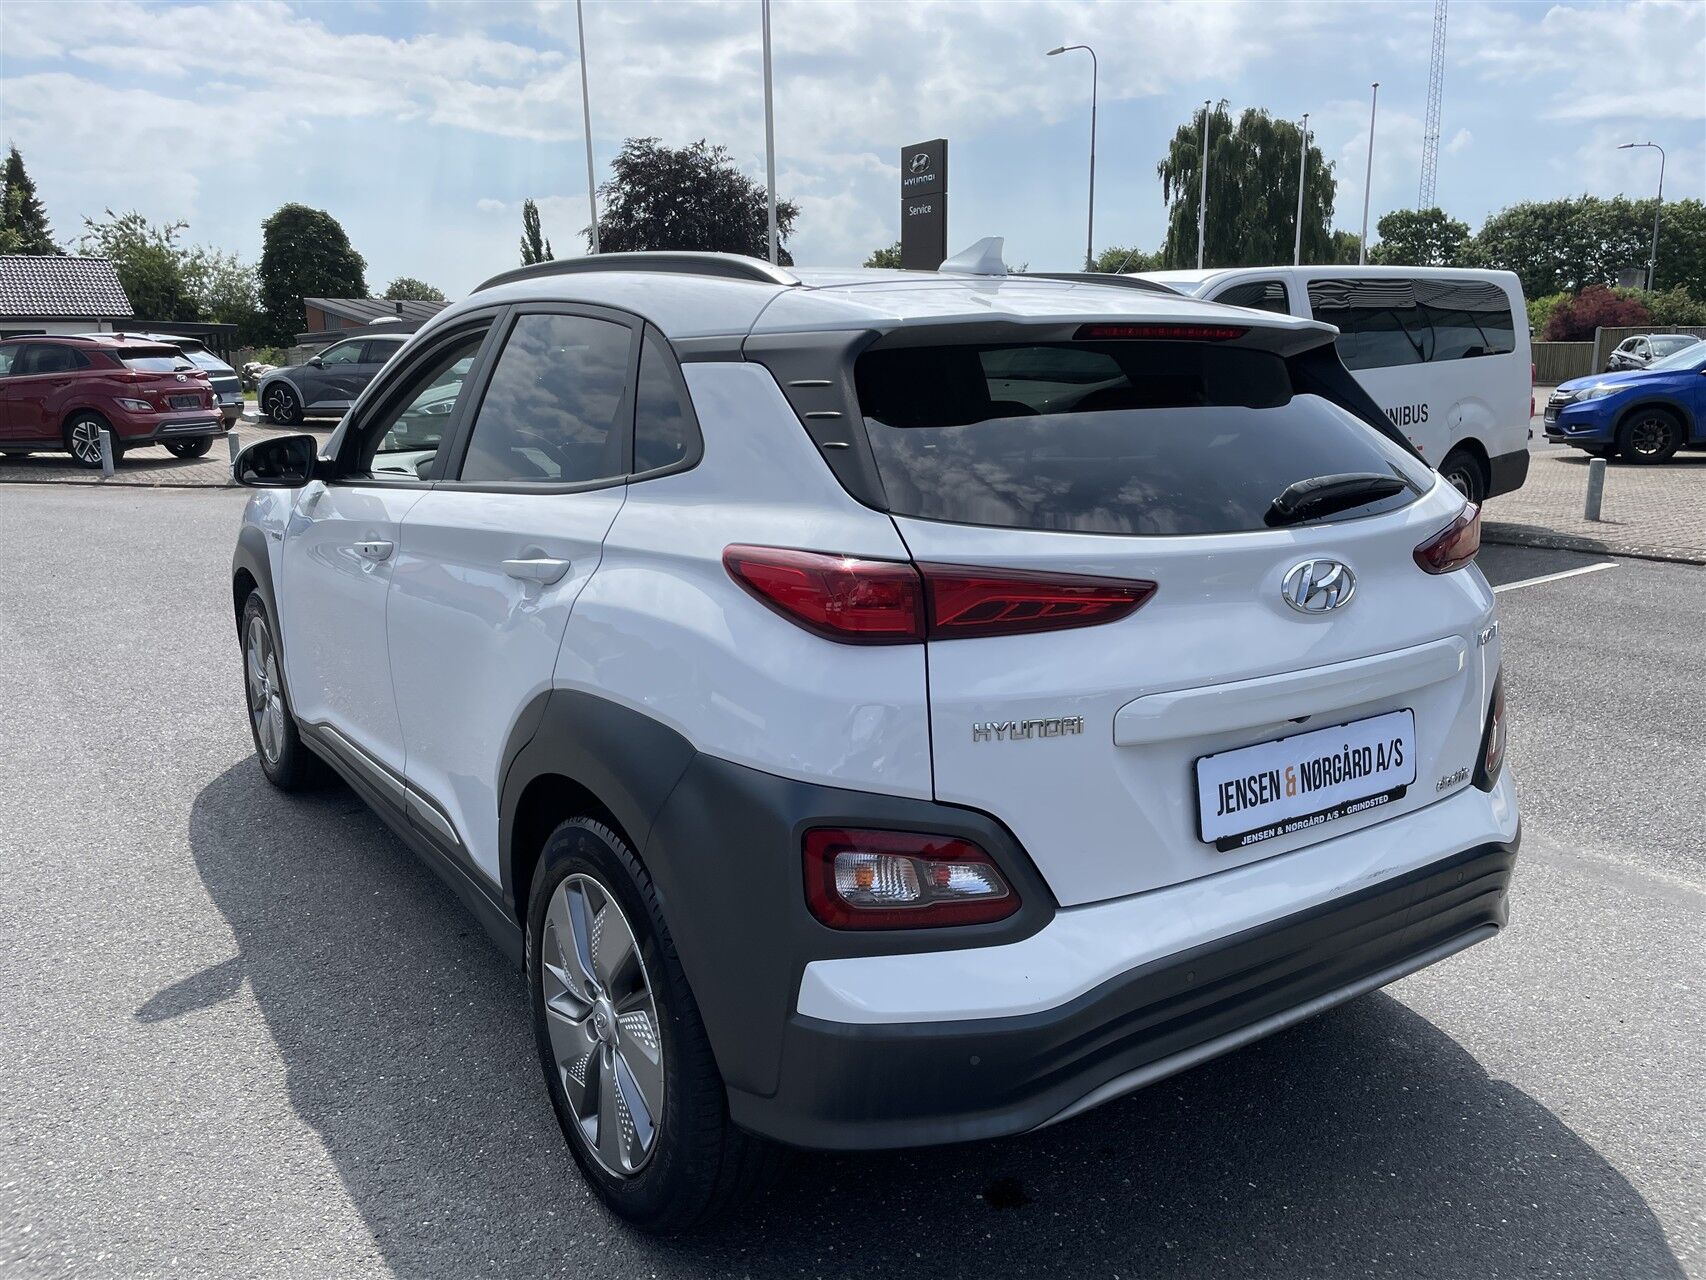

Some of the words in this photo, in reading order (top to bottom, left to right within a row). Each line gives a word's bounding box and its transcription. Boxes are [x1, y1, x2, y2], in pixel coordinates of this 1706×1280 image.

[904, 174, 935, 186] HYUNDAI
[909, 204, 931, 216] Service
[1386, 403, 1428, 427] NIBUS
[973, 715, 1084, 742] HYUNDAI
[1217, 769, 1281, 816] JENSEN
[1284, 766, 1297, 798] &
[1300, 744, 1373, 794] NØRGÅRD
[1376, 738, 1404, 773] A/S
[1241, 829, 1275, 845] JENSEN
[1277, 827, 1284, 836] &
[1285, 814, 1325, 833] NØRGÅRD
[1326, 810, 1339, 822] A/S
[1347, 794, 1389, 815] GRINDSTED
